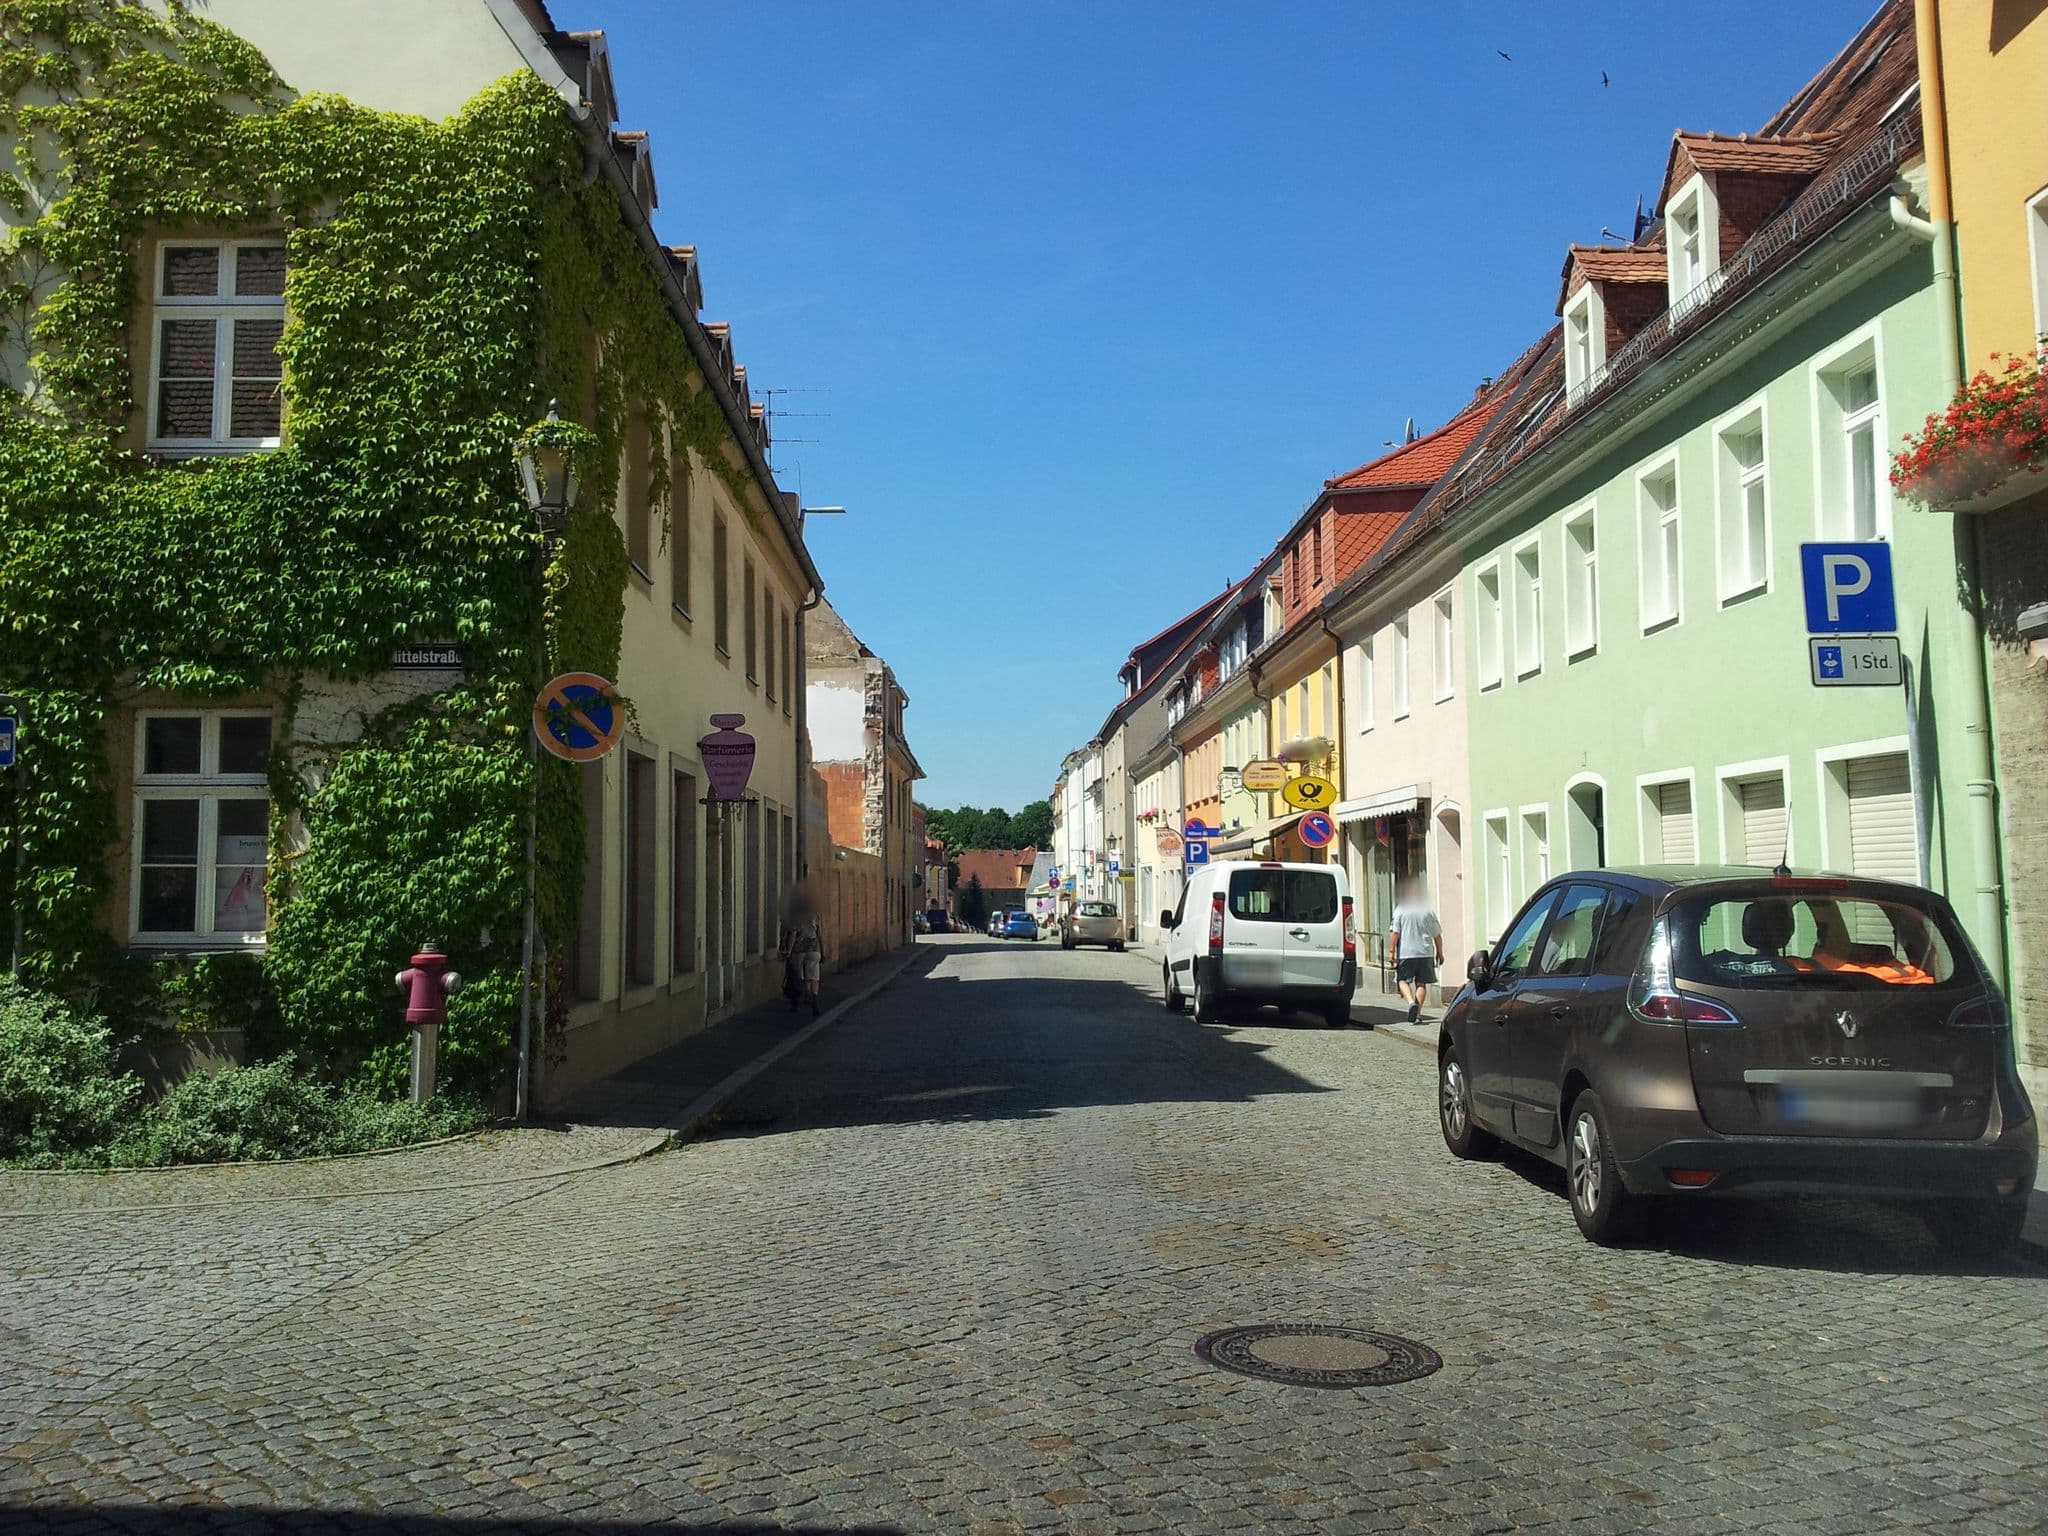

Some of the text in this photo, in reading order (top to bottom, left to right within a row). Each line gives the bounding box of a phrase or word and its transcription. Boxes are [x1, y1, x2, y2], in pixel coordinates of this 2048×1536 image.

[1823, 554, 1872, 622] P
[1851, 654, 1893, 669] 1 Std.
[1189, 843, 1203, 862] P
[1110, 862, 1117, 871] P
[1809, 1056, 1892, 1067] SCENIC
